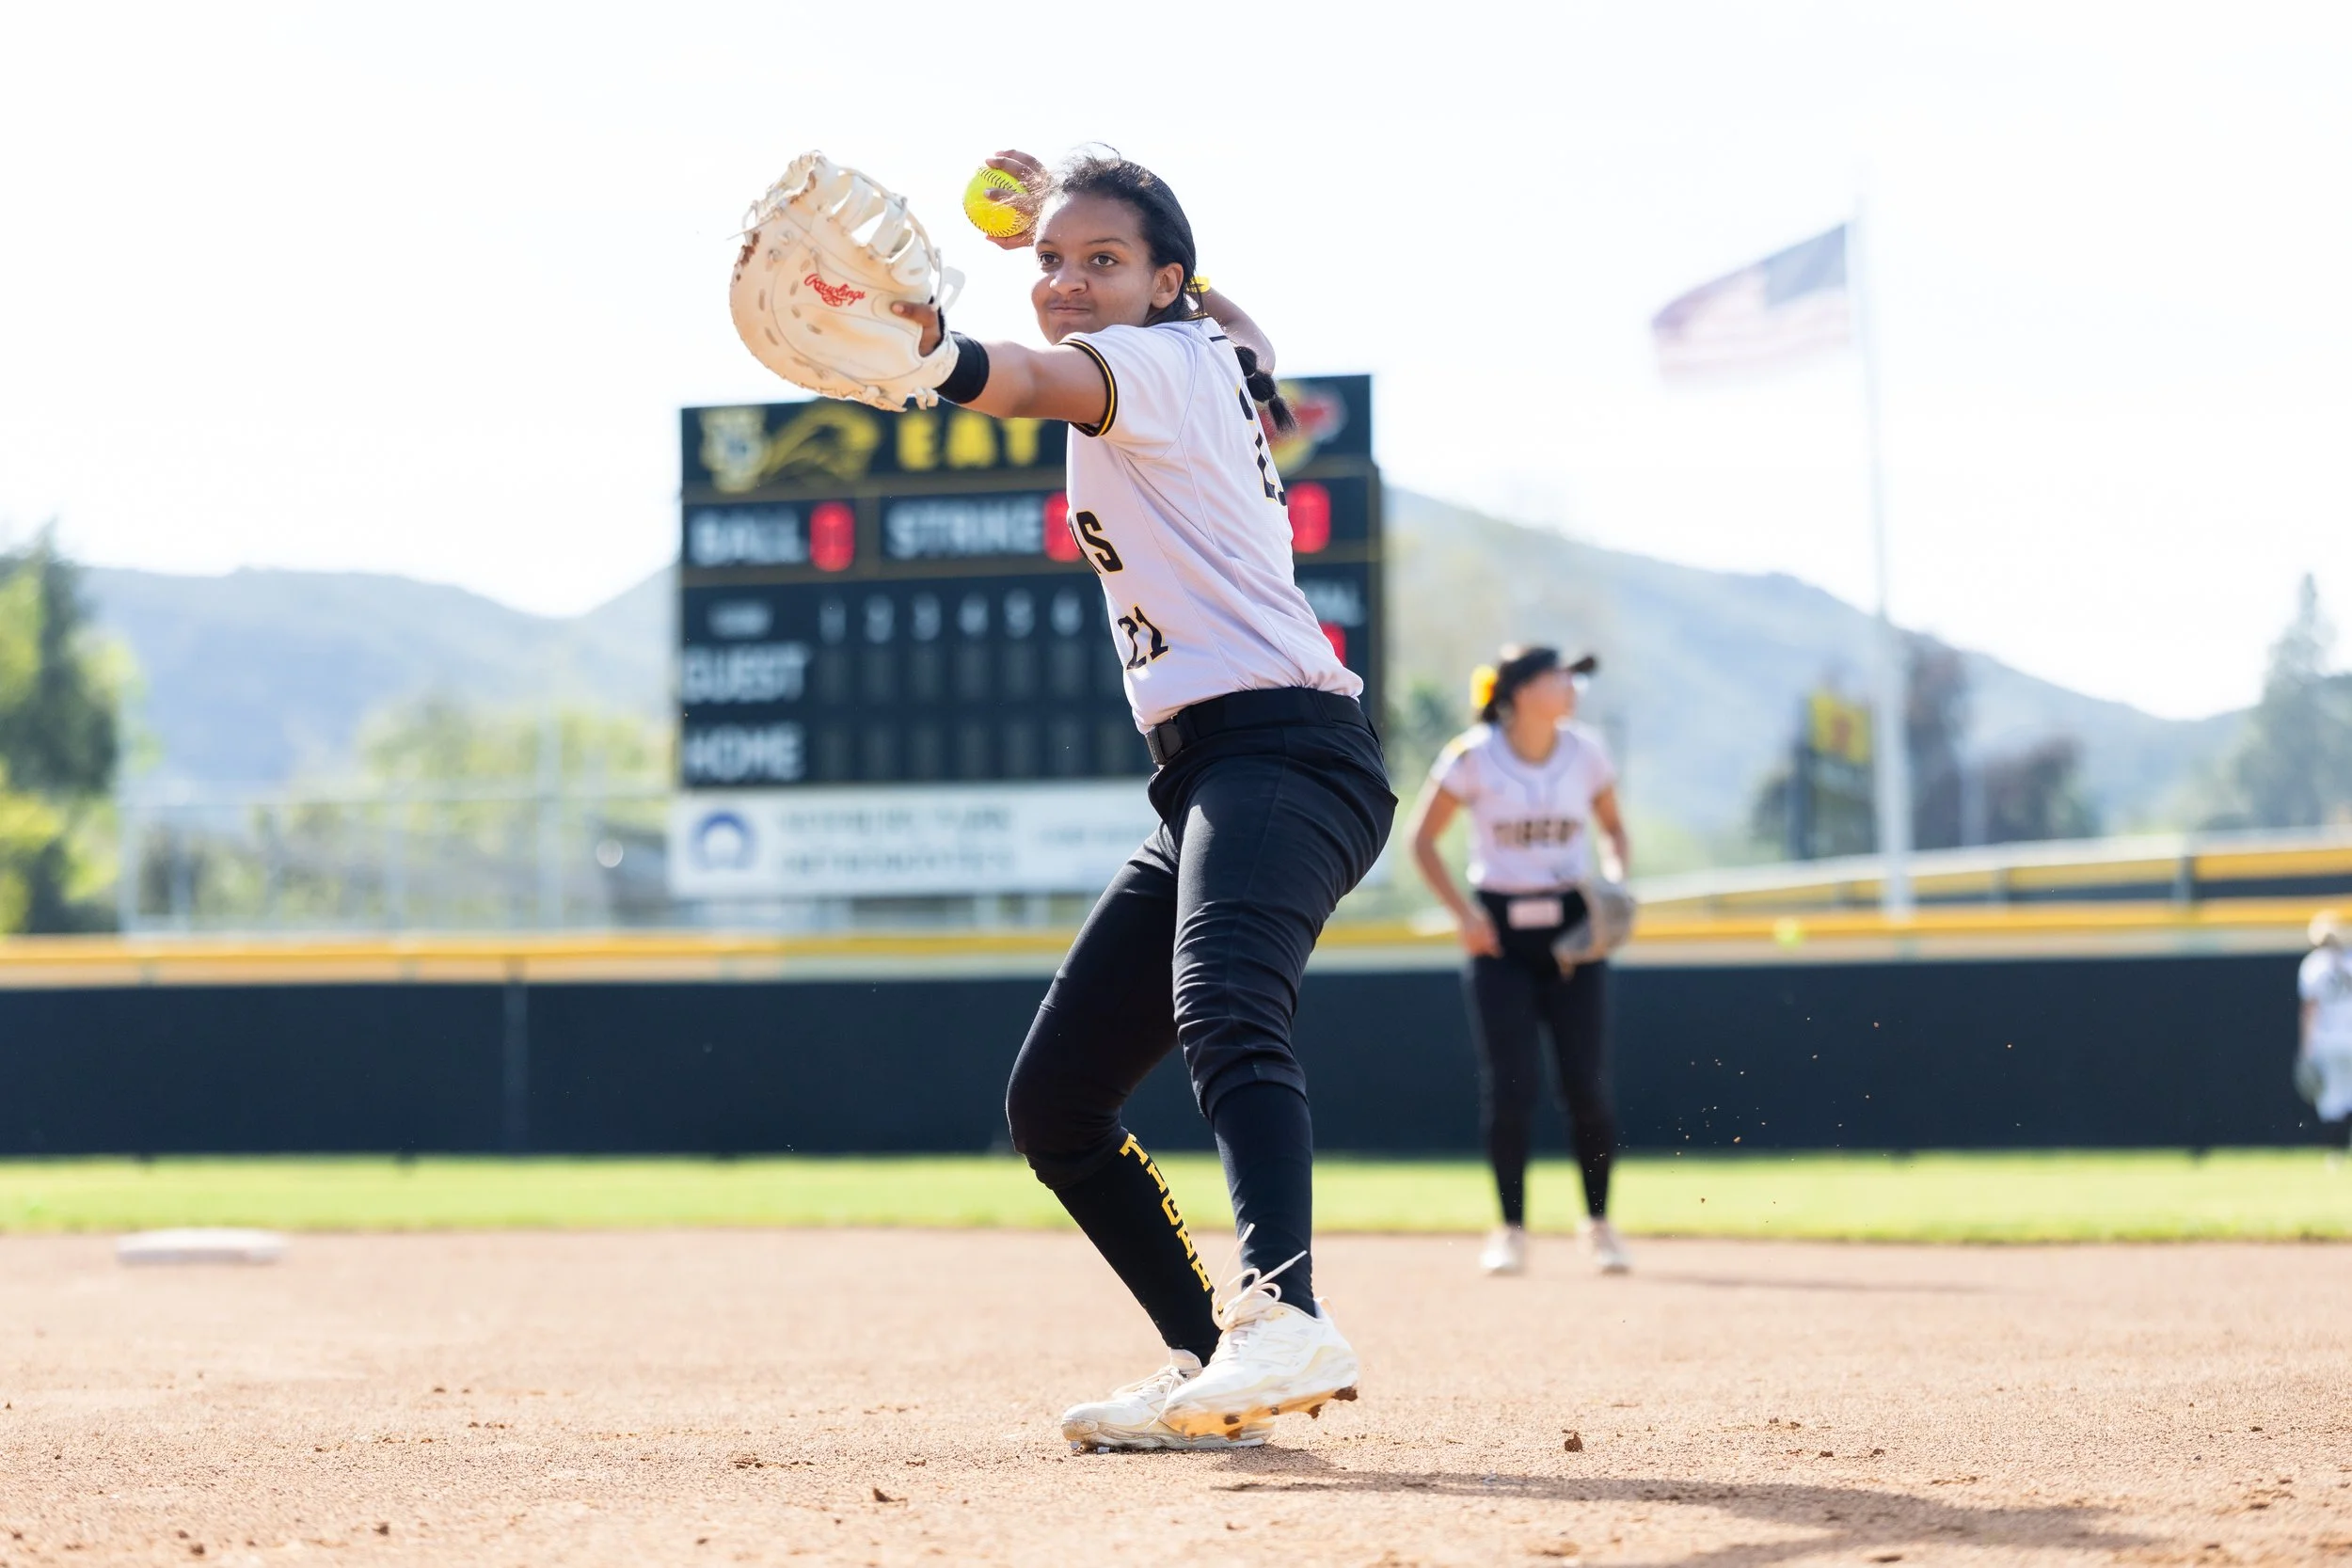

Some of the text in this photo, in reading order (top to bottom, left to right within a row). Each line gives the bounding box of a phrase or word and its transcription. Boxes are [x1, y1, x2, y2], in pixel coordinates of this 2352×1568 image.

[804, 273, 866, 307] Rawlings
[692, 509, 806, 564] BALL
[888, 499, 1043, 561] STRIKE
[1117, 604, 1169, 671] 21
[682, 643, 808, 703] GUEST
[684, 723, 803, 780] HOME
[1120, 1132, 1223, 1319] TIGER
